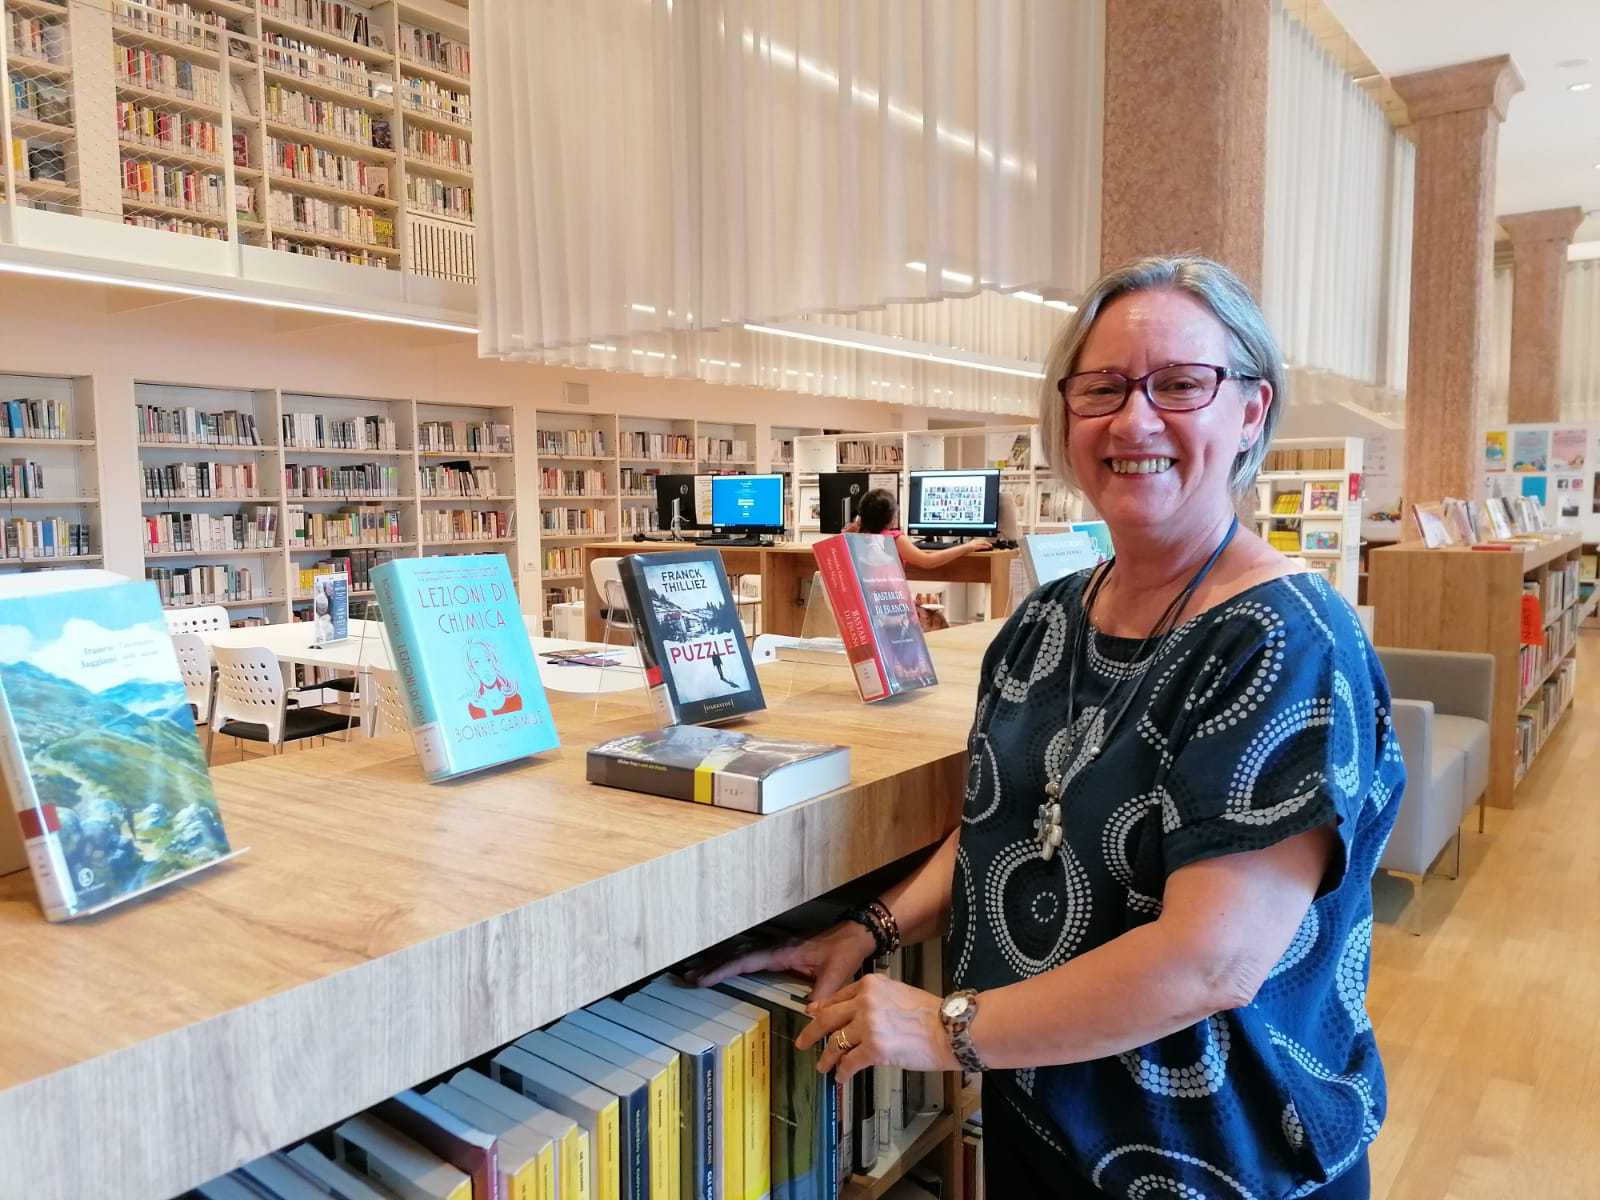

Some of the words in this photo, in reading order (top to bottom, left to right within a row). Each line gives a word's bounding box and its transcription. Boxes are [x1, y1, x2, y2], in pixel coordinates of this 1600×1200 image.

[661, 569, 703, 582] FRANCK
[662, 579, 708, 593] THILLIEZ
[418, 585, 486, 608] LEZIONI
[491, 583, 508, 602] DI
[438, 608, 506, 634] CHIMICA
[670, 638, 737, 664] PUZZLE
